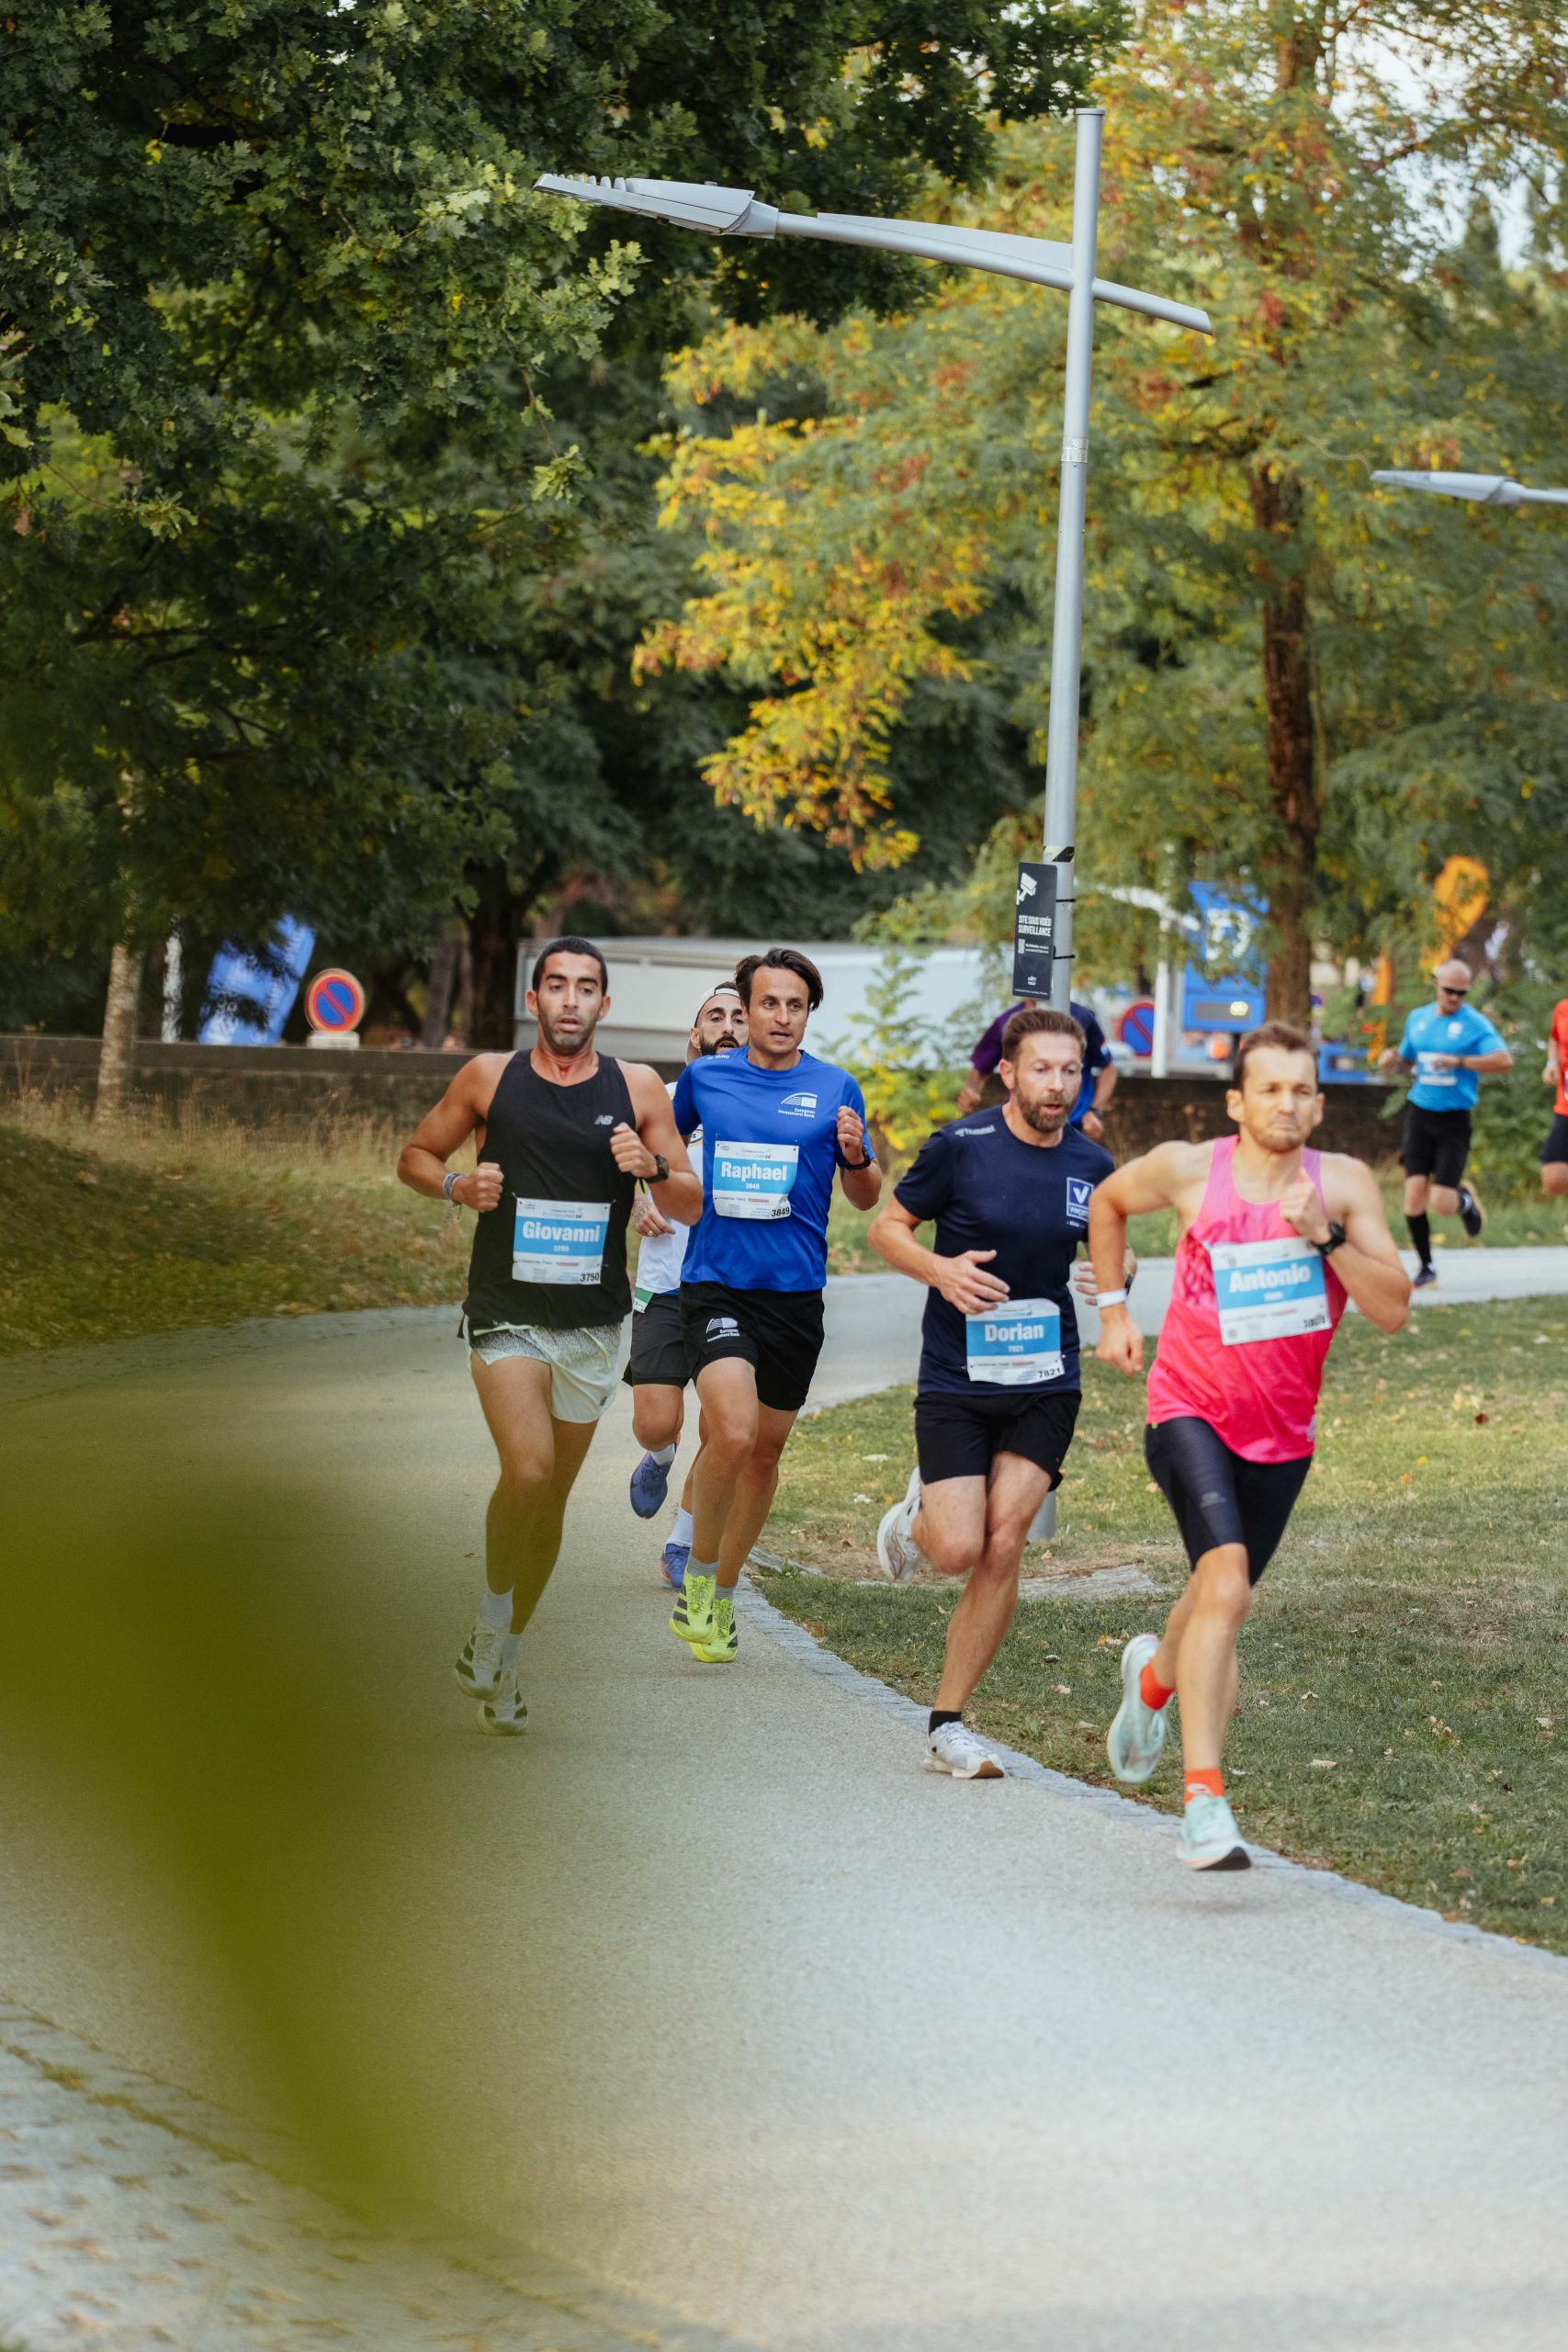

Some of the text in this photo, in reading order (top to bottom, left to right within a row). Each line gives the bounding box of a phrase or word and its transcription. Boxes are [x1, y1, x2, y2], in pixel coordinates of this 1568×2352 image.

[1018, 924, 1052, 937] SURVEILLANCE
[721, 1161, 788, 1182] Raphael
[771, 1206, 790, 1217] 3849
[522, 1220, 602, 1243] Giovanni
[580, 1272, 600, 1283] 3750
[1229, 1262, 1312, 1294] Antonio
[984, 1323, 1044, 1342] Dorian
